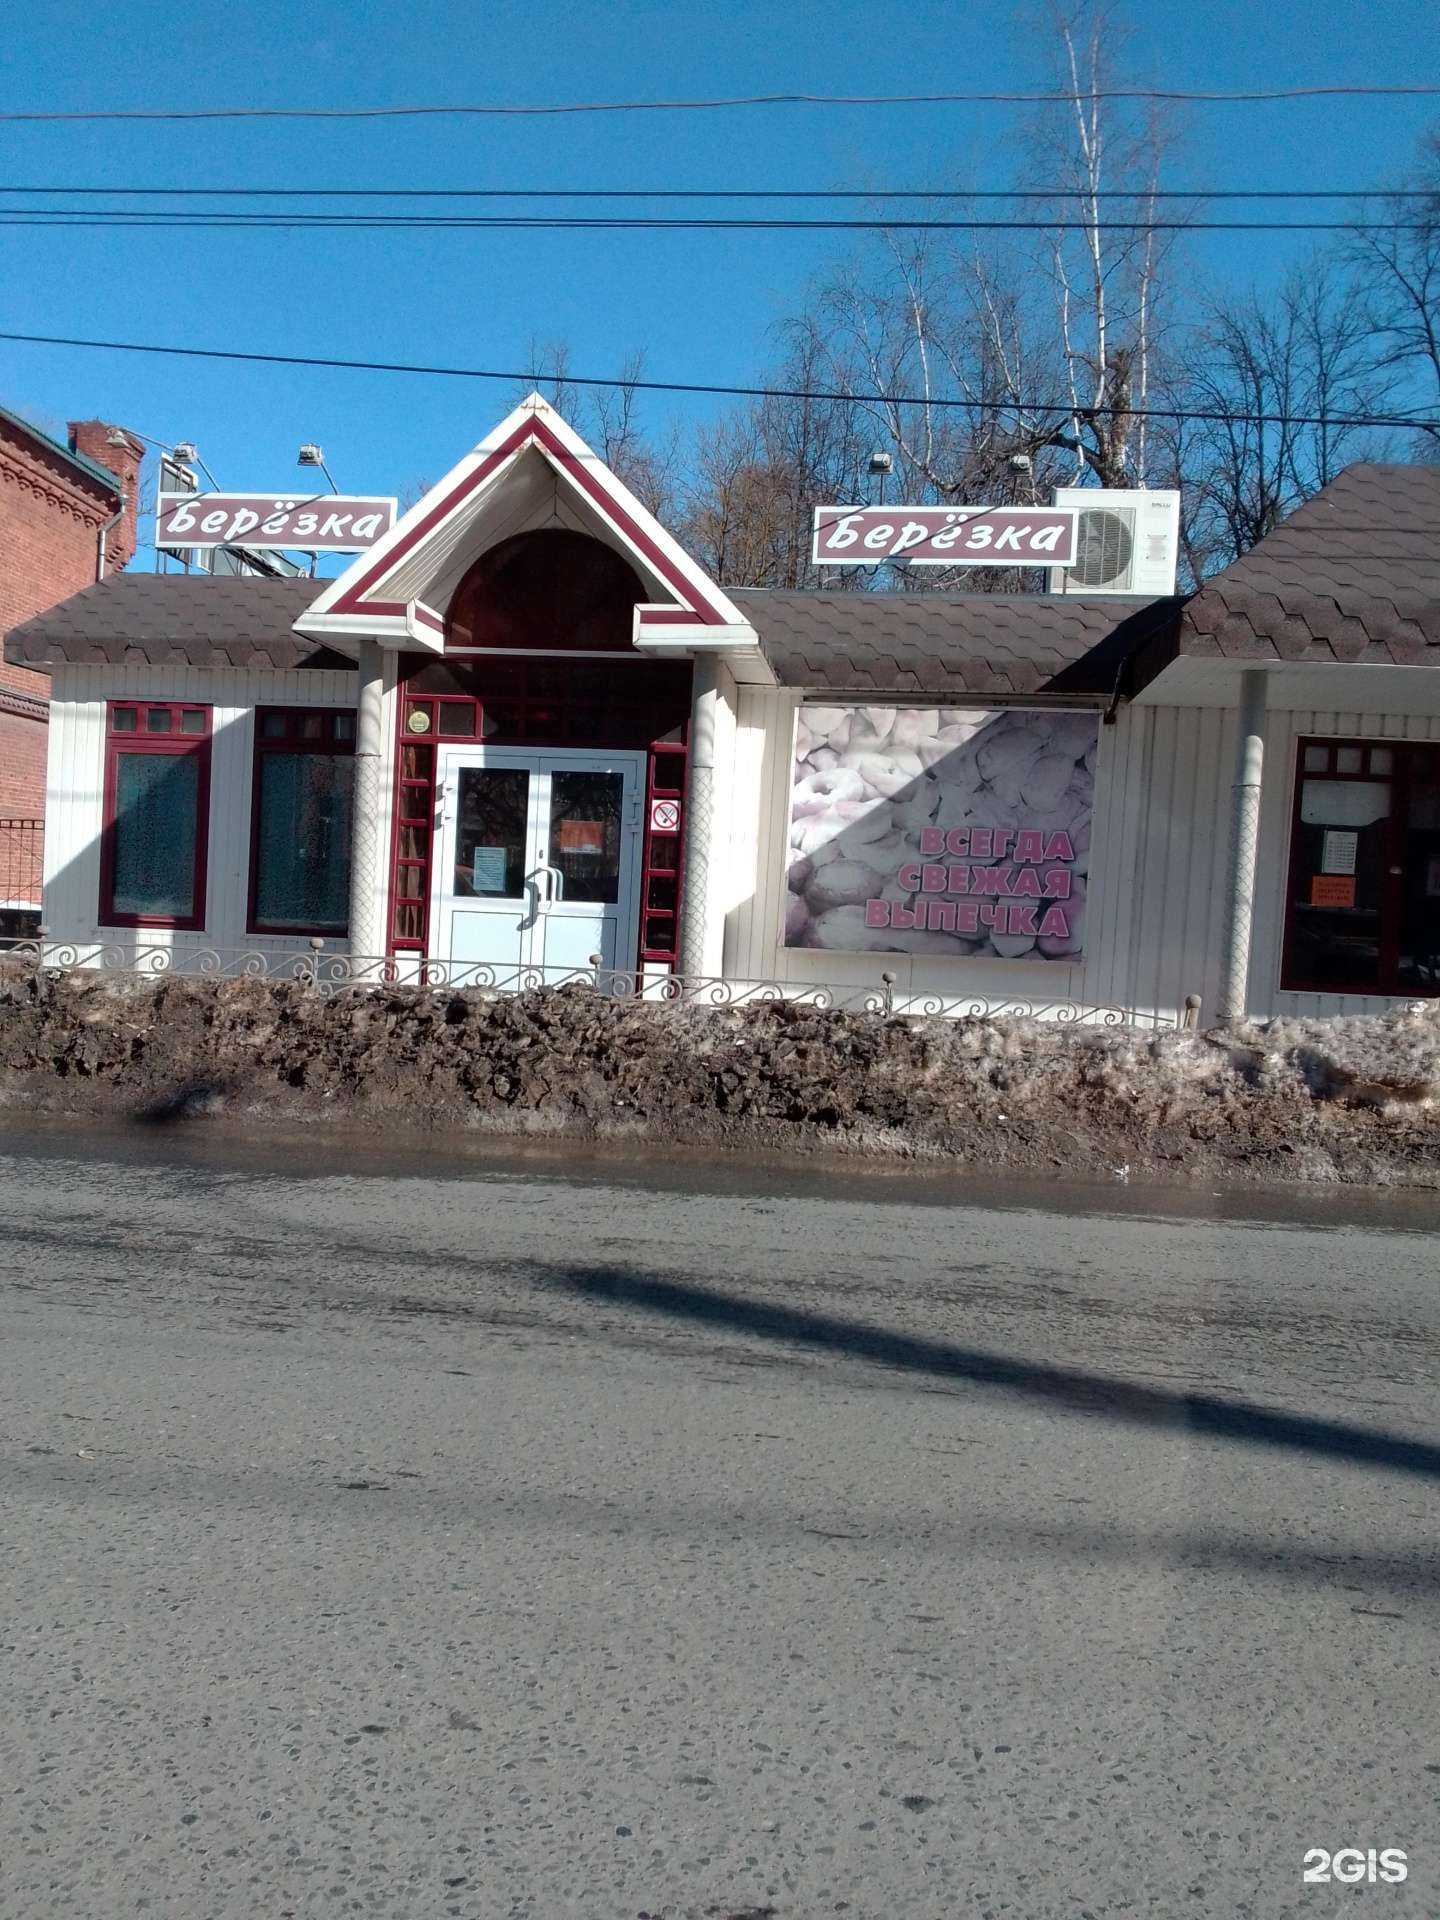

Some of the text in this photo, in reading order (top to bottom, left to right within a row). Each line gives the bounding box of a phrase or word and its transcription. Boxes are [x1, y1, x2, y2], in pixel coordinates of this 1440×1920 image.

[166, 500, 383, 541] Берёзка
[825, 514, 1066, 555] Берёзка
[919, 826, 1075, 864] ВСЕГДА
[898, 863, 1071, 898] СВЕЖАЯ
[865, 898, 1070, 937] ВЫПЕЧКА
